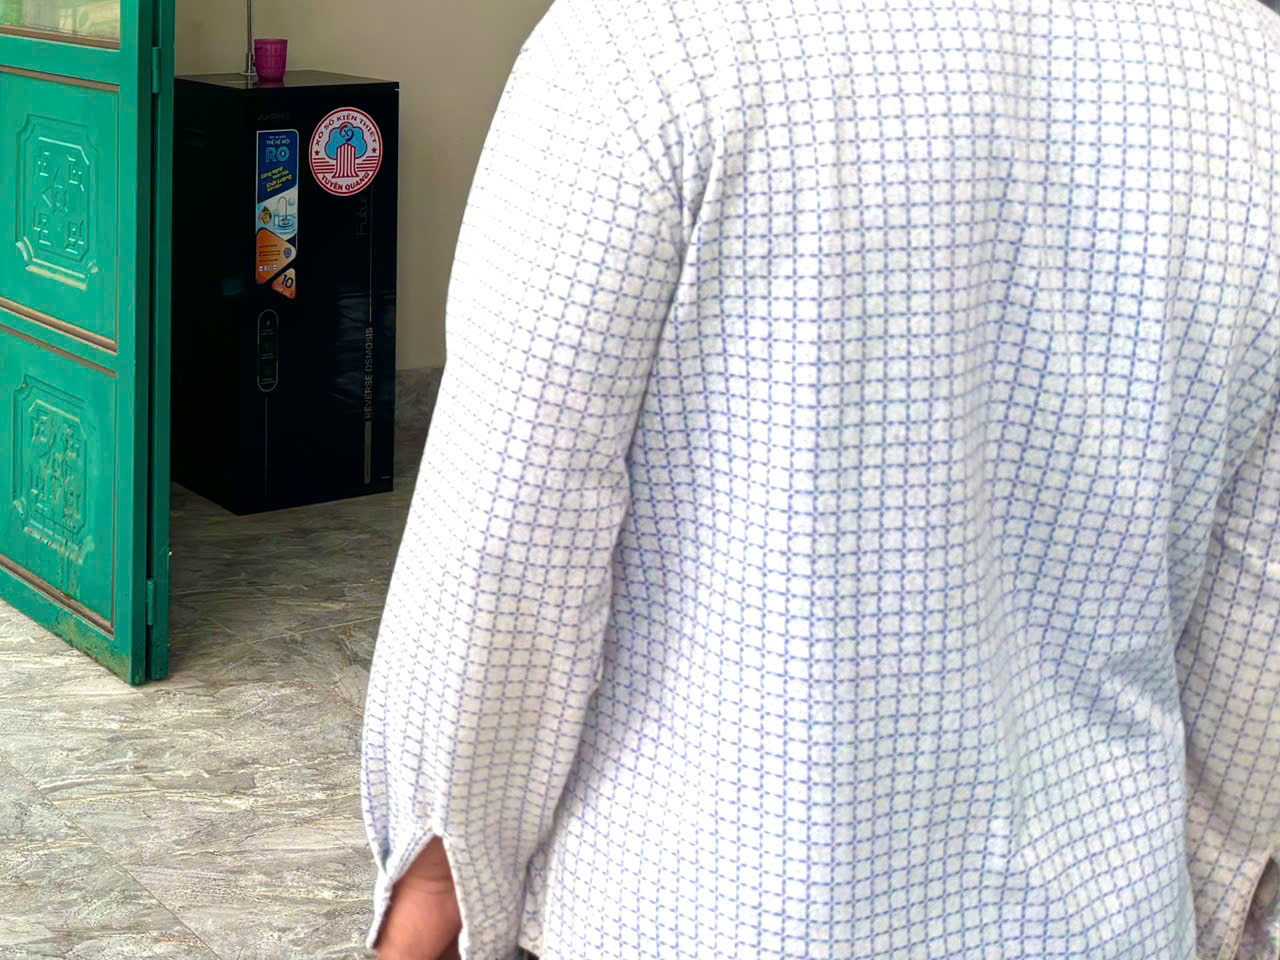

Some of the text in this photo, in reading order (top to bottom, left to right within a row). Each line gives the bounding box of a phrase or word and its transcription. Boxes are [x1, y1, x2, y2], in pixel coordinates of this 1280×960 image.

[265, 146, 290, 162] RO
[344, 171, 370, 191] QUANG
[281, 274, 294, 289] 10
[364, 327, 375, 419] REVERSE OSMOSIS
